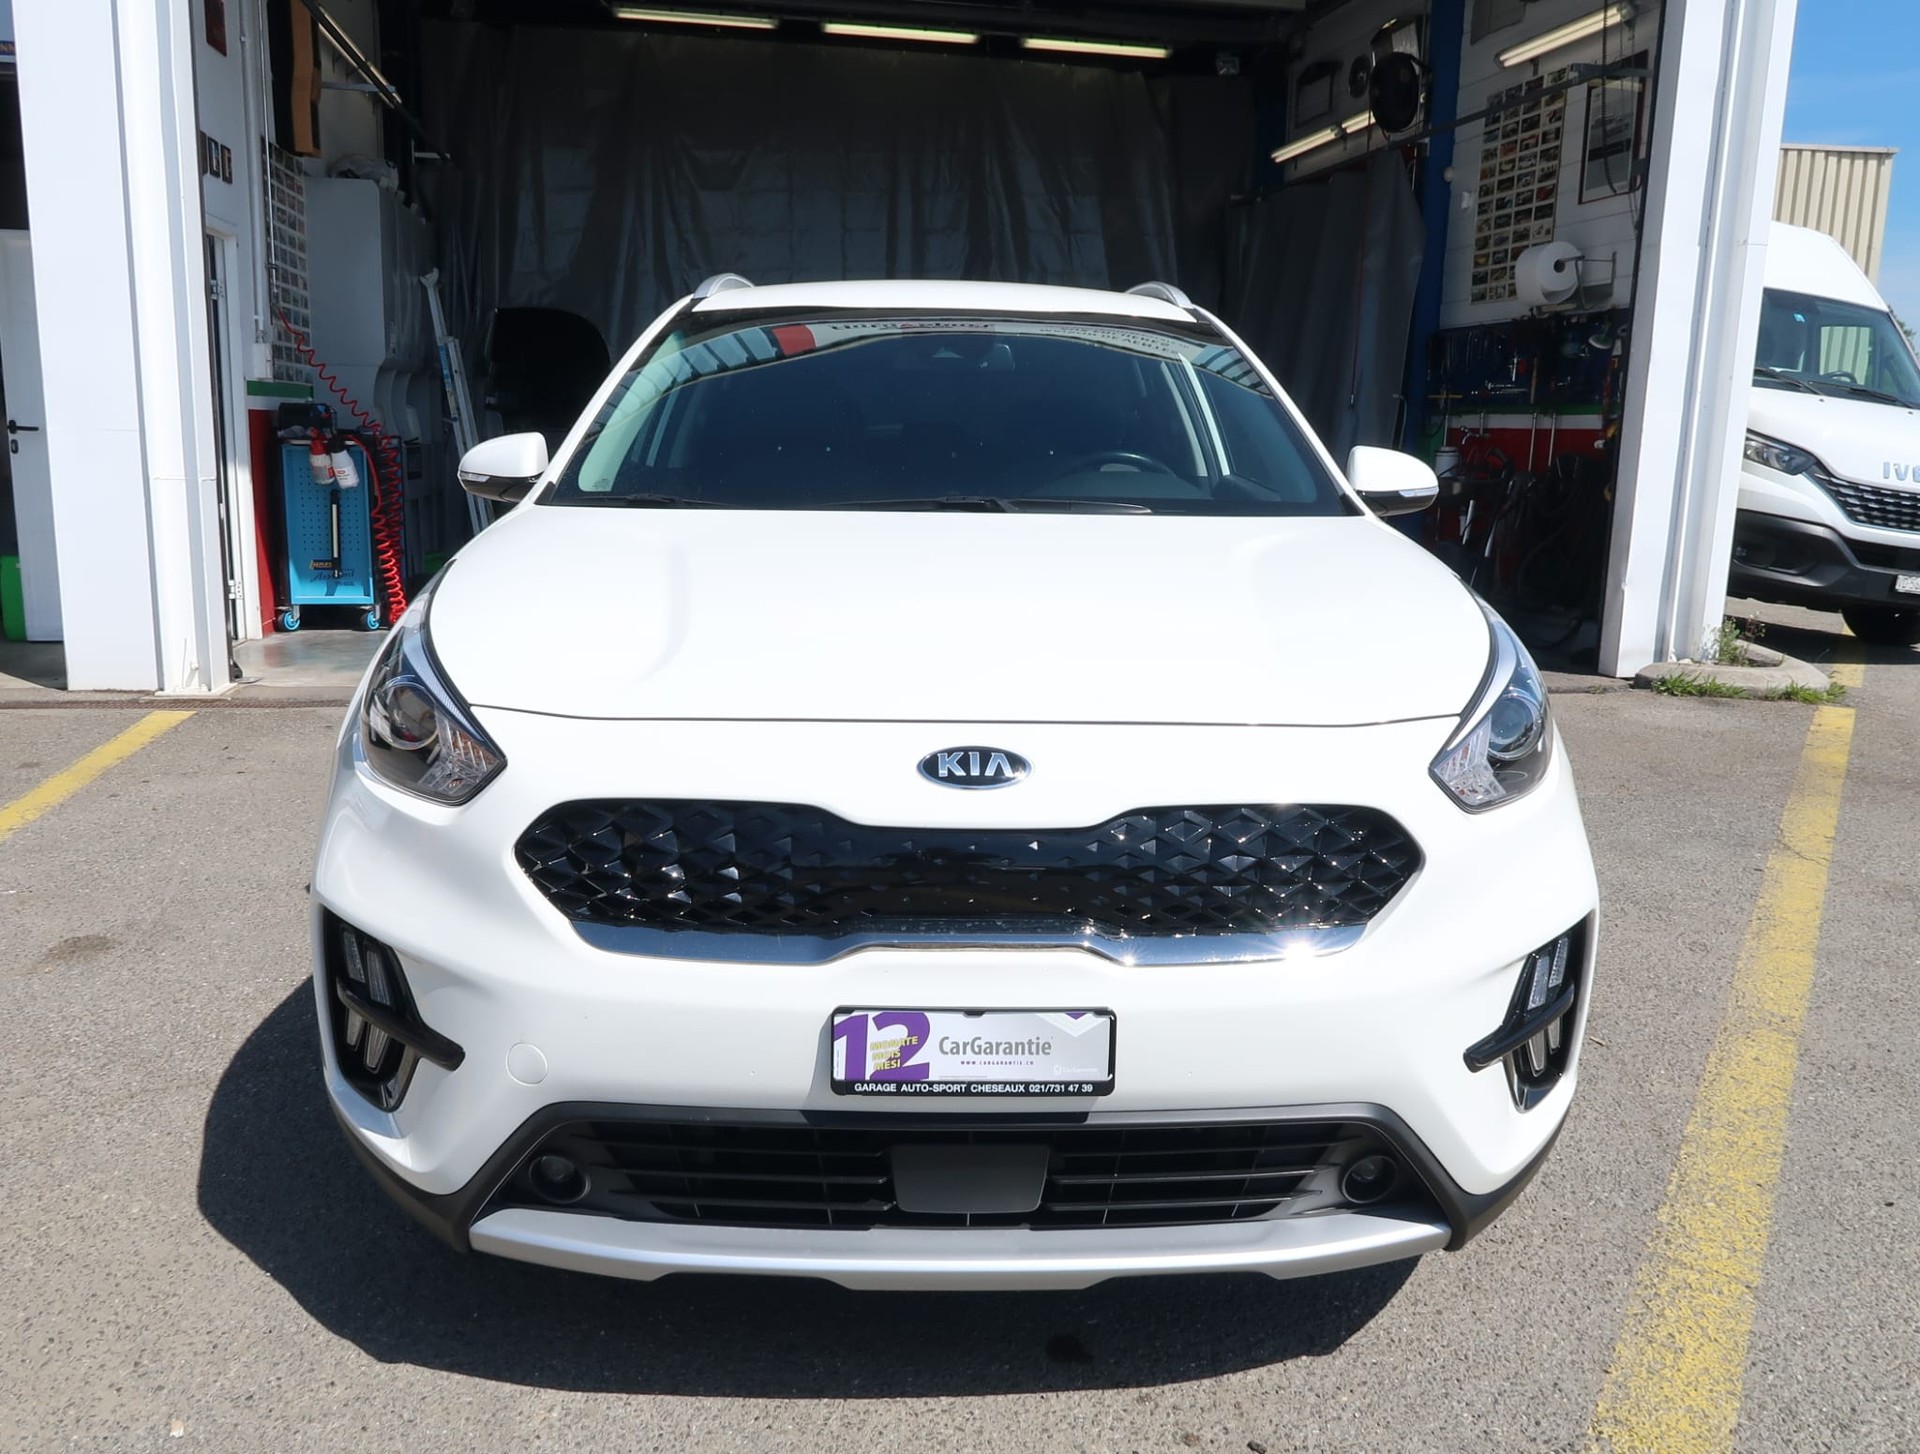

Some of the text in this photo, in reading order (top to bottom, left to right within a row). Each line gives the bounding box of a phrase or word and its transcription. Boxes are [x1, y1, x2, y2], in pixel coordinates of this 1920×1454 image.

[937, 751, 1015, 778] KIA
[834, 1011, 930, 1080] 12
[870, 1035, 919, 1051] MONATE
[939, 1036, 1052, 1056] CarGarantie
[872, 1049, 901, 1062] MOIS
[873, 1058, 901, 1071] MESI
[854, 1083, 1094, 1093] GARAGE AUTO-SPORT CHESEAUX 021/731 47 39
